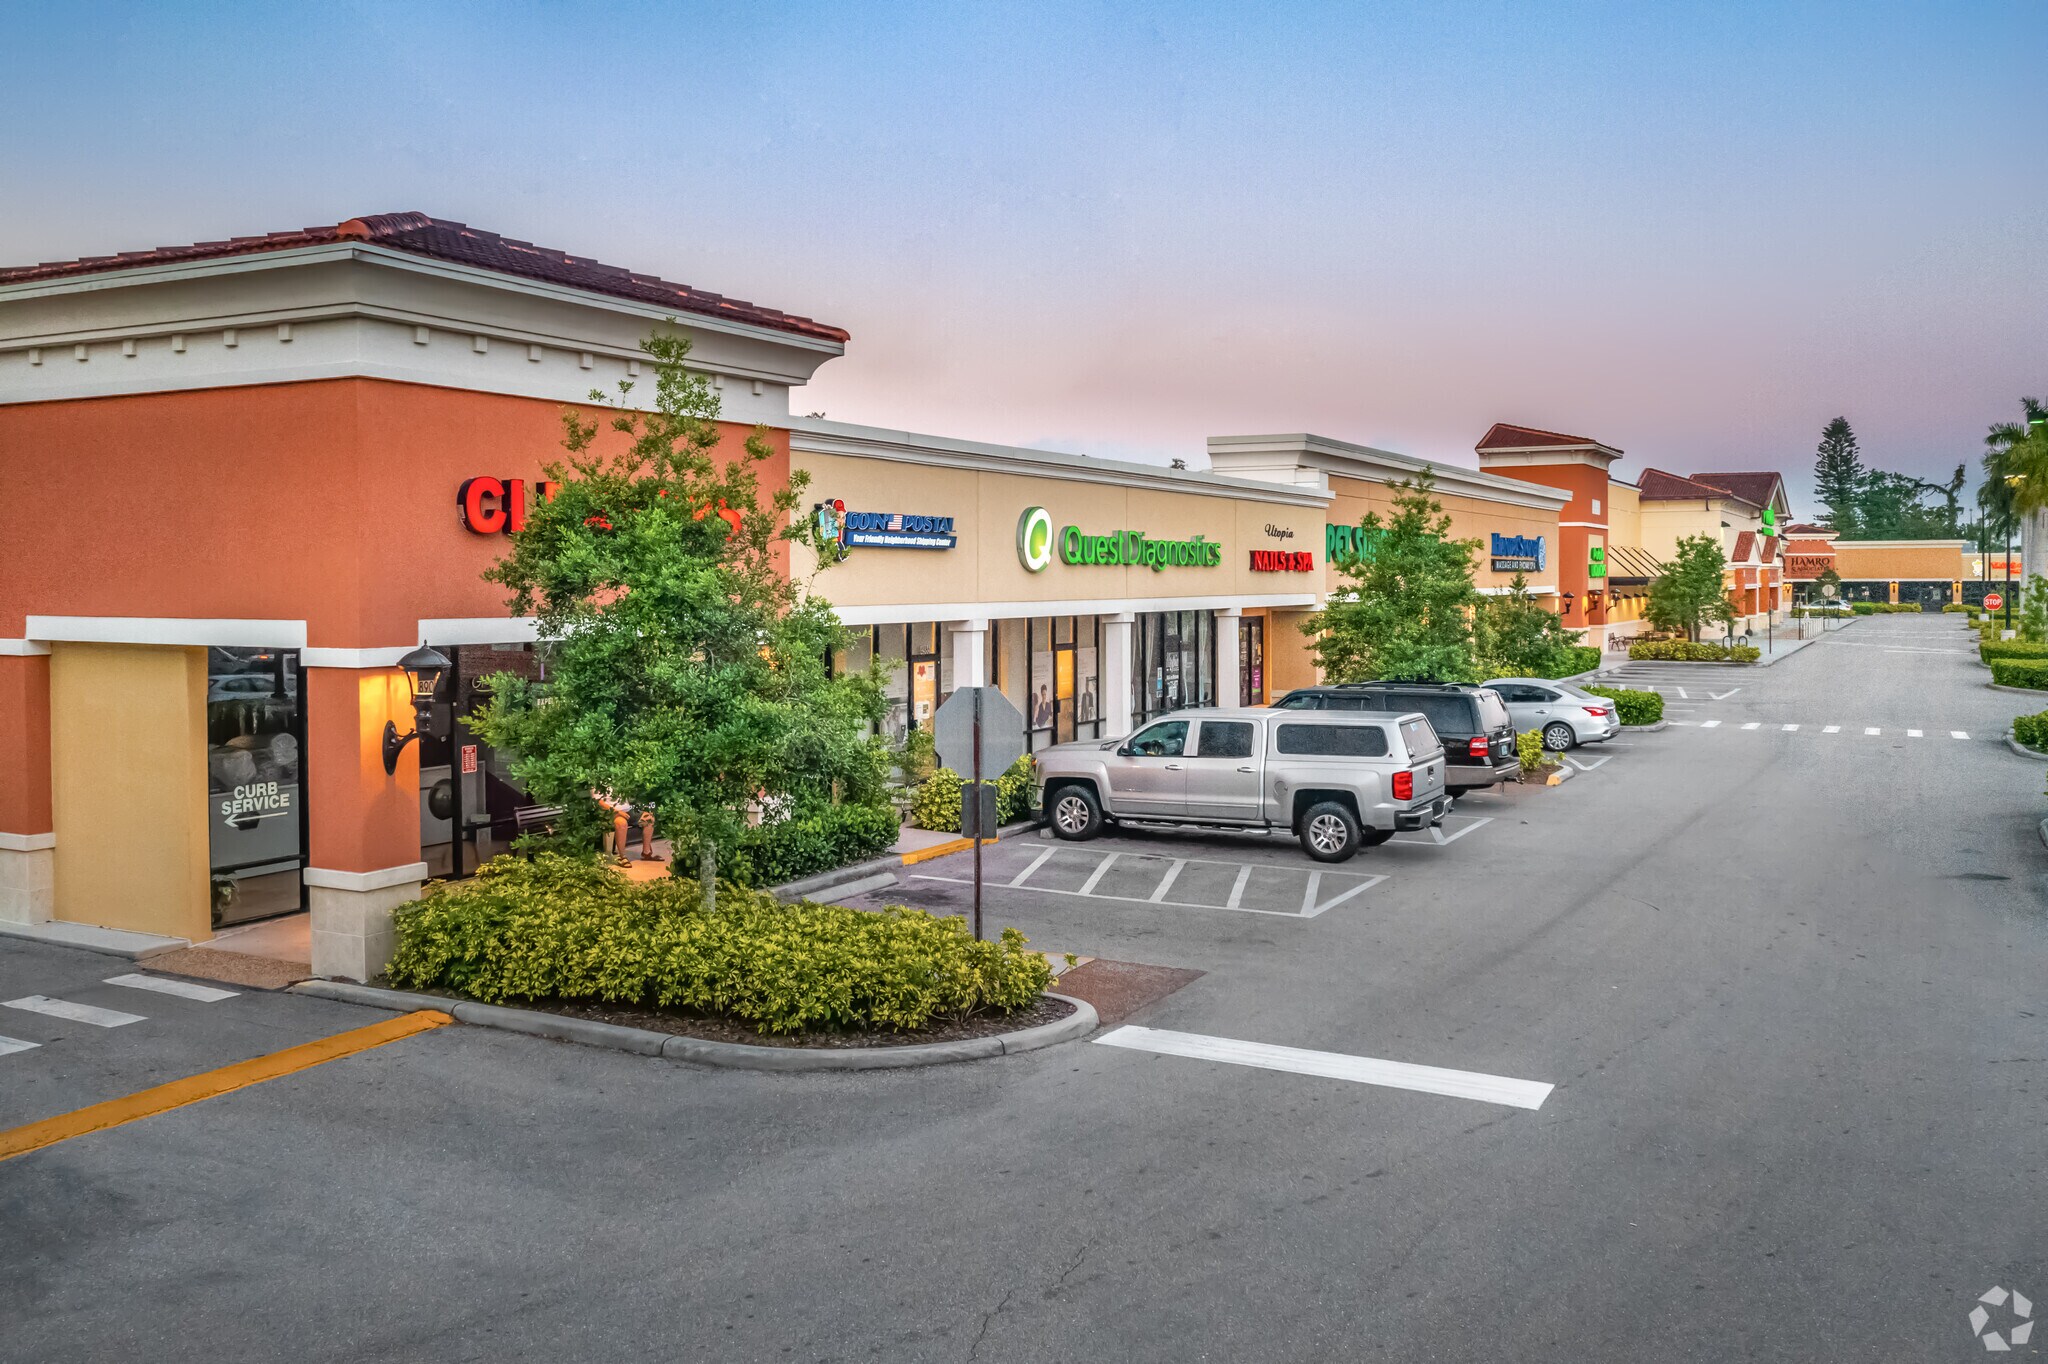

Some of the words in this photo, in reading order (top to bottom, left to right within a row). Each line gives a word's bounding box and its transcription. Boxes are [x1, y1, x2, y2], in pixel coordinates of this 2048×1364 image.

[901, 515, 956, 533] POSTAL
[1264, 523, 1295, 541] Utopia
[853, 534, 865, 543] Your
[864, 534, 884, 545] Friendly
[884, 535, 917, 546] Neighborhood
[916, 537, 936, 547] Shipping
[936, 538, 952, 547] Center
[1060, 526, 1124, 565] Quest
[1128, 531, 1221, 571] Diagnostics
[1326, 523, 1351, 563] PET
[1250, 550, 1287, 571] NAILS
[1296, 551, 1314, 572] SPA
[1985, 598, 2002, 606] STOP
[234, 781, 278, 799] CURB
[221, 793, 290, 815] SERVICE
